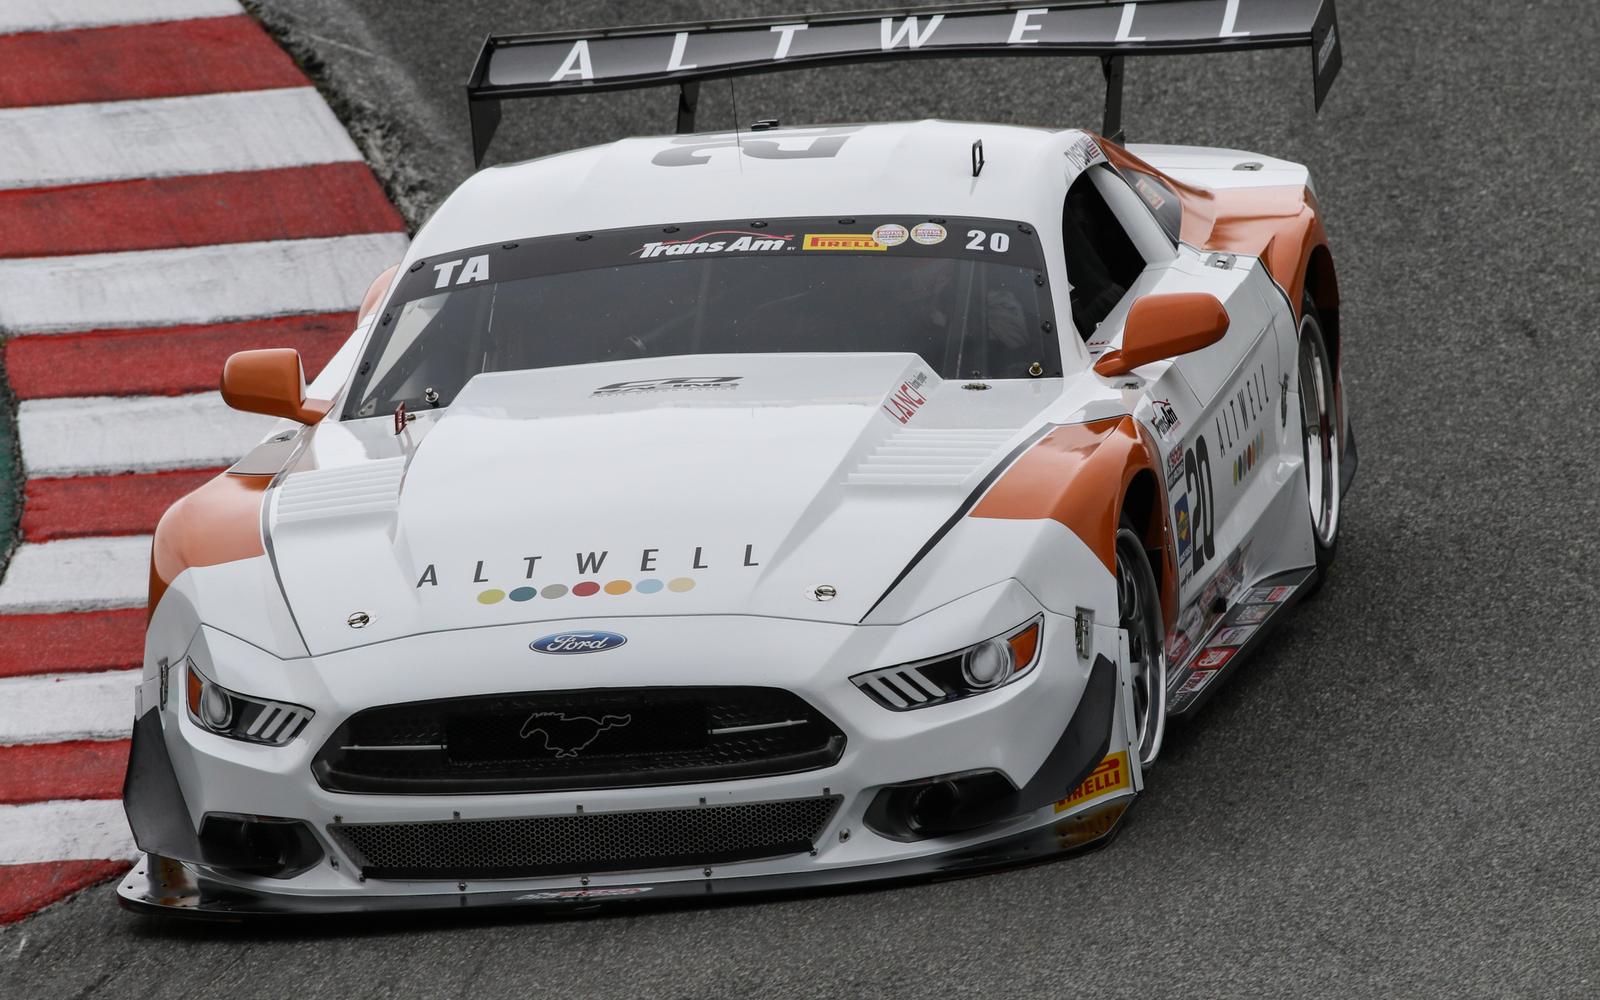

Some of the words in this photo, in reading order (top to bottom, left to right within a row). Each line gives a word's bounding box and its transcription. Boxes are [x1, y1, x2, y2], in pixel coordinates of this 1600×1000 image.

[549, 0, 1250, 84] ALTWELL
[638, 242, 727, 258] Trans
[724, 236, 785, 253] Am
[965, 229, 1010, 253] 20
[433, 254, 490, 289] TA
[1215, 363, 1269, 458] ALTWELL
[1185, 434, 1215, 576] 20
[416, 544, 759, 588] ALTWELL
[546, 633, 608, 651] Ford
